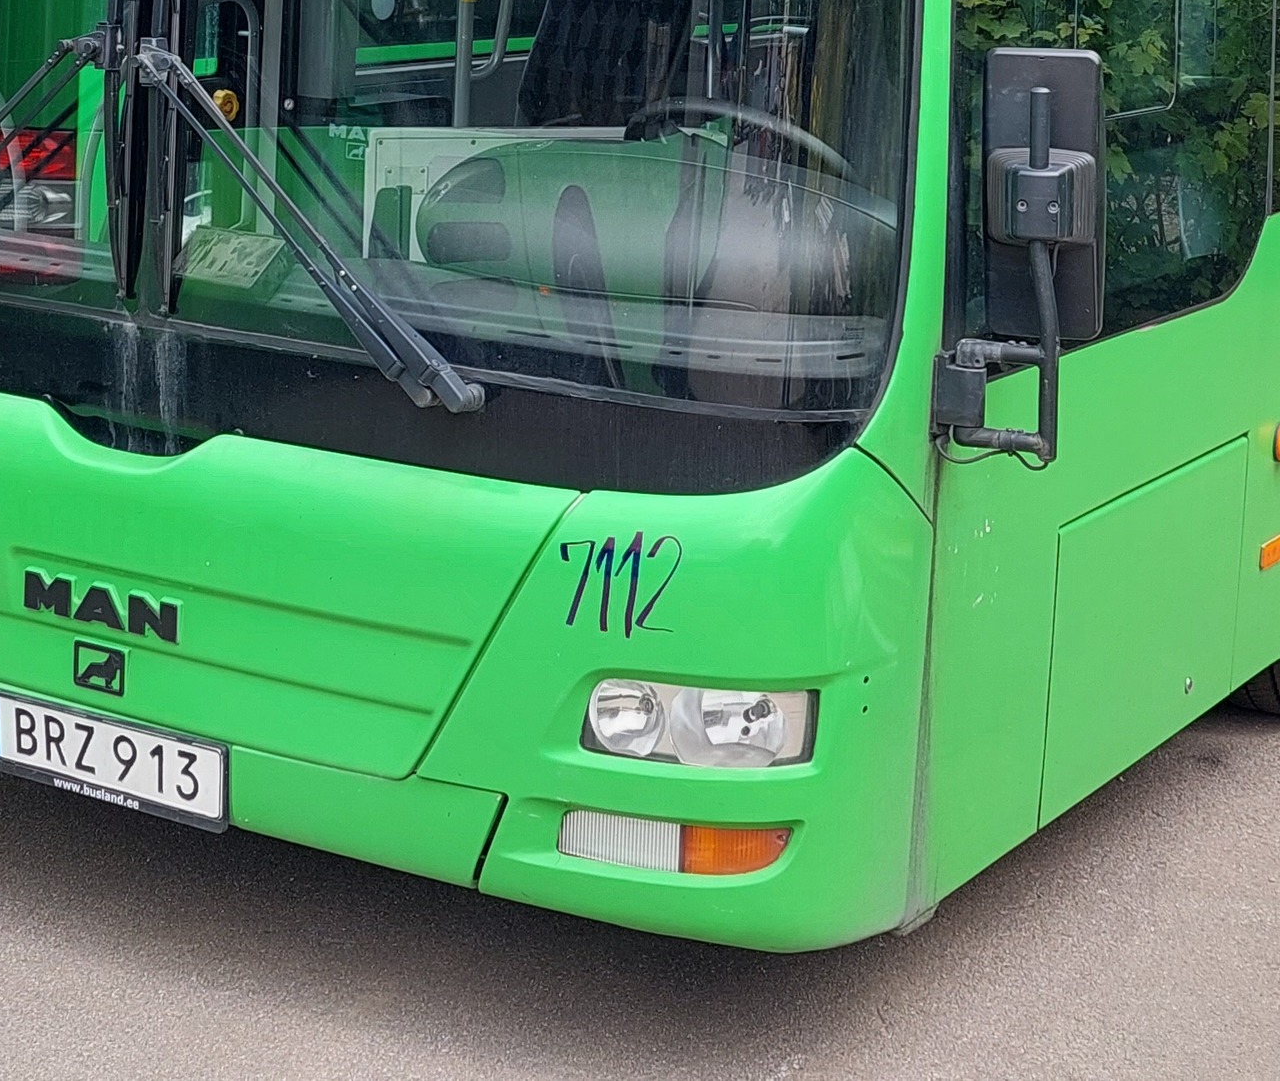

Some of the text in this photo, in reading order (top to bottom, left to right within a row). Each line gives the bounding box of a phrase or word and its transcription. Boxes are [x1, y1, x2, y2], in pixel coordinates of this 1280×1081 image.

[329, 123, 366, 141] MA
[23, 567, 180, 645] MAN
[560, 531, 683, 639] 7112
[14, 707, 96, 775] BRZ
[112, 734, 200, 801] 913
[53, 777, 140, 810] www.busland.ee
